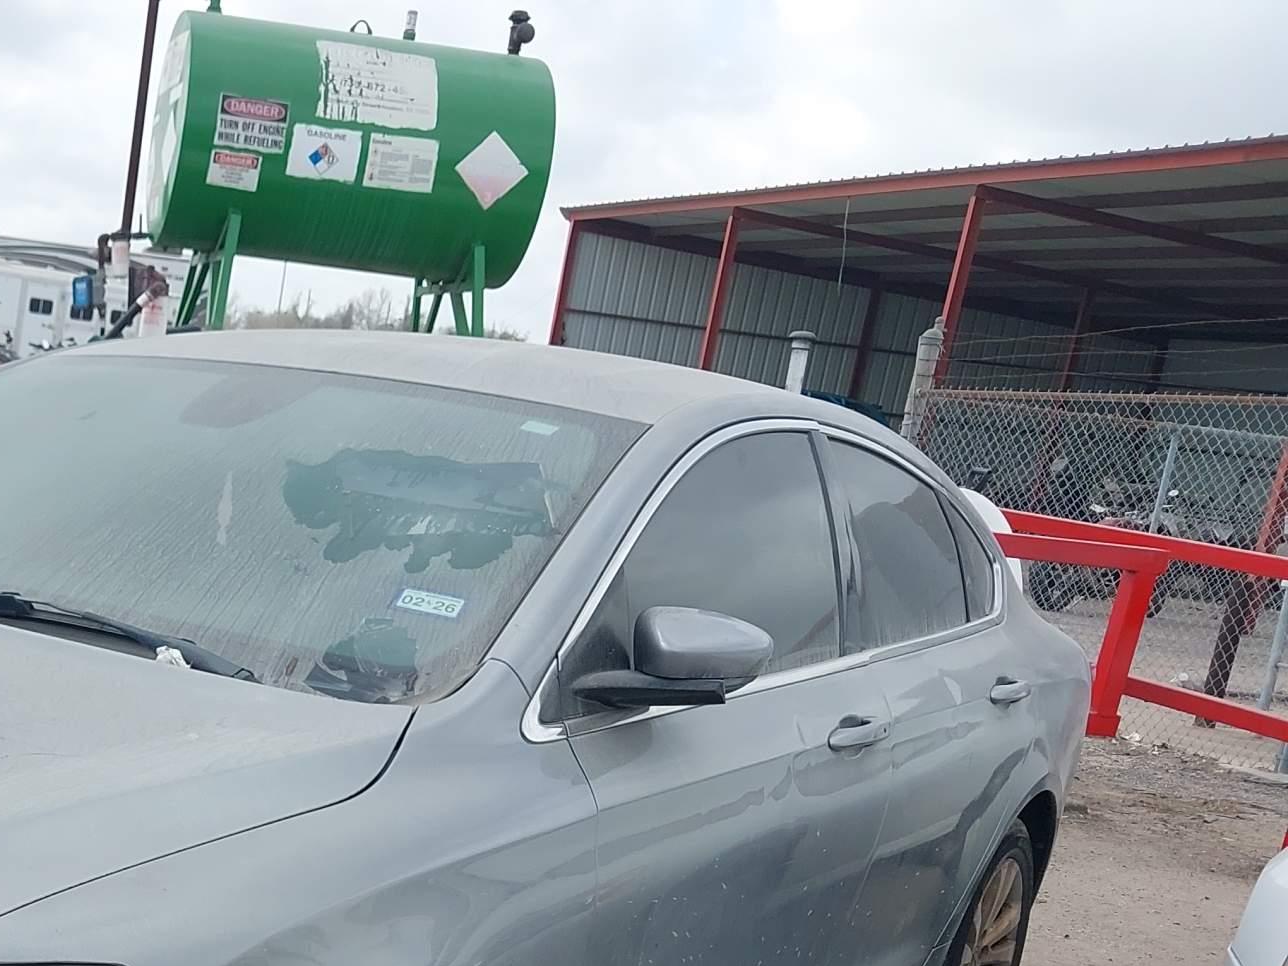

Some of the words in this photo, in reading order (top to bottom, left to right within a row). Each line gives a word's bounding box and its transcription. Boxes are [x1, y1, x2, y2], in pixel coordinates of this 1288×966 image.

[230, 100, 280, 118] DANGER
[219, 118, 240, 130] TURN
[241, 122, 256, 133] OFF
[258, 124, 286, 138] ENGINE
[306, 129, 348, 142] GASOLINE
[216, 131, 242, 144] WHILE
[243, 135, 285, 150] REFUELING
